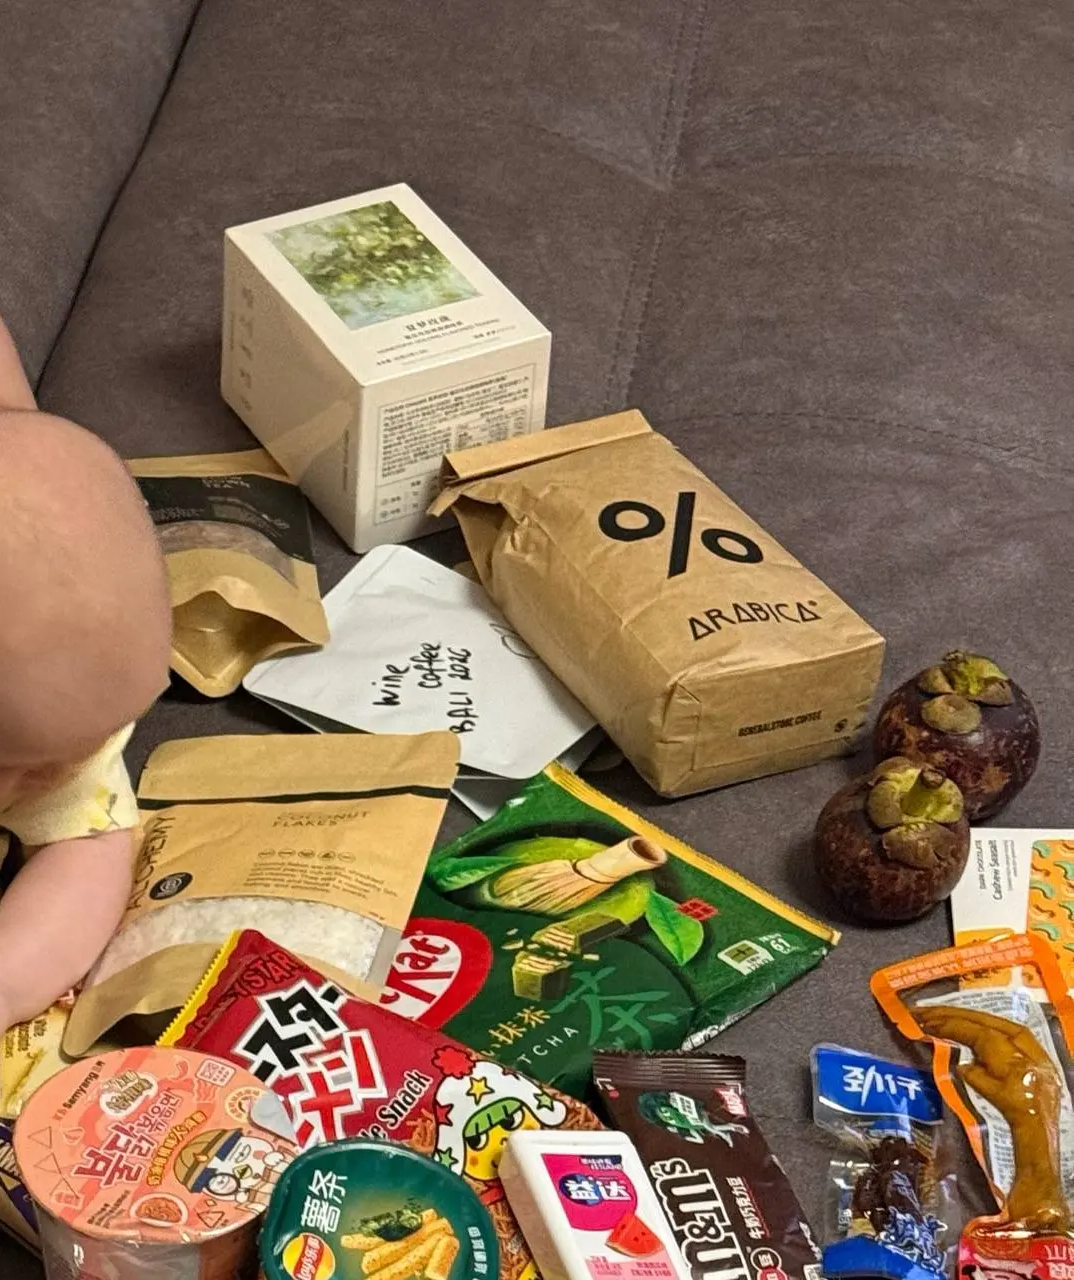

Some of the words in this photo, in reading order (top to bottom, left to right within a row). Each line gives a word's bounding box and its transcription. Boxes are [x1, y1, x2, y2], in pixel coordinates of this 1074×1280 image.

[687, 601, 822, 641] ARABICA
[519, 1027, 578, 1066] TCHA
[65, 1070, 99, 1111] Samyang
[377, 1070, 430, 1128] Snack
[301, 1169, 347, 1233] 薯条
[567, 1179, 631, 1201] 益达
